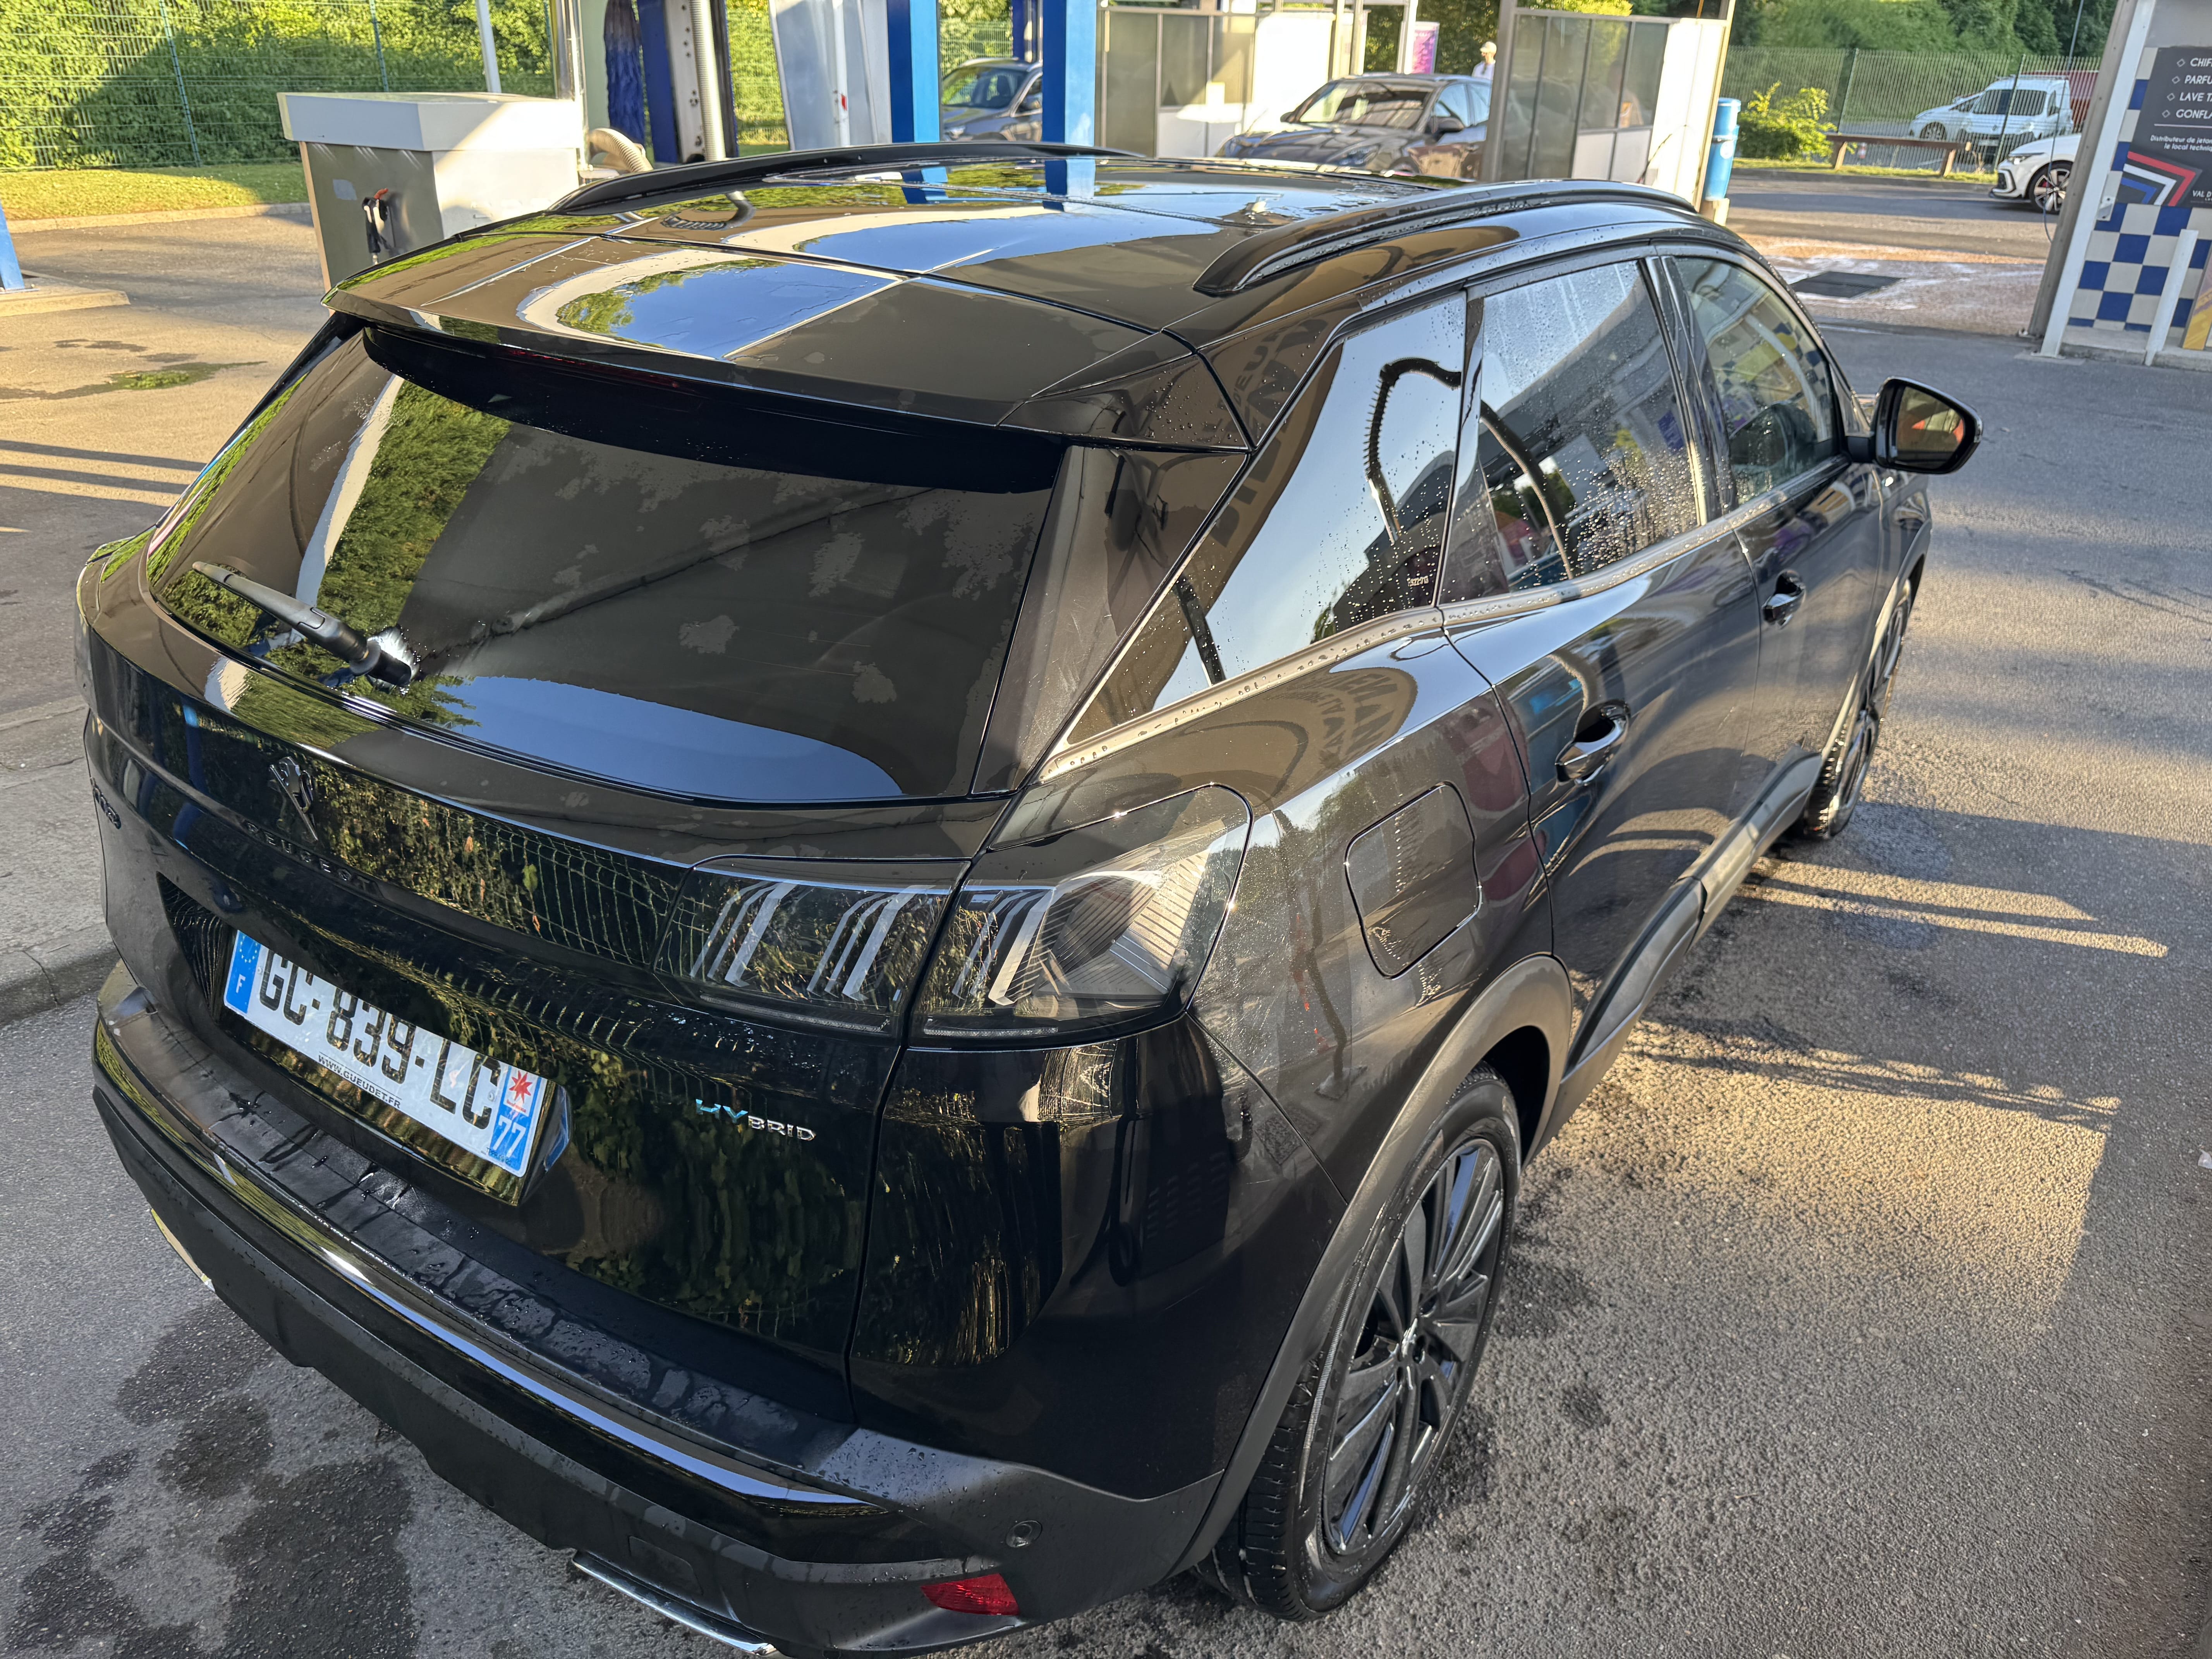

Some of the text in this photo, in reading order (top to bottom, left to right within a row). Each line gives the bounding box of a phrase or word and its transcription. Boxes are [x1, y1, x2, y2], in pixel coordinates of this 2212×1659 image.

[2190, 57, 2212, 67] CHIF
[2179, 92, 2204, 102] LAVE
[2150, 135, 2186, 143] Distributeur
[235, 974, 246, 994] F
[259, 948, 502, 1130] GC-839-LC
[318, 1054, 401, 1109] WWW.GUEUDET.FR
[696, 1099, 816, 1141] HYBRID
[492, 1115, 526, 1158] 77
